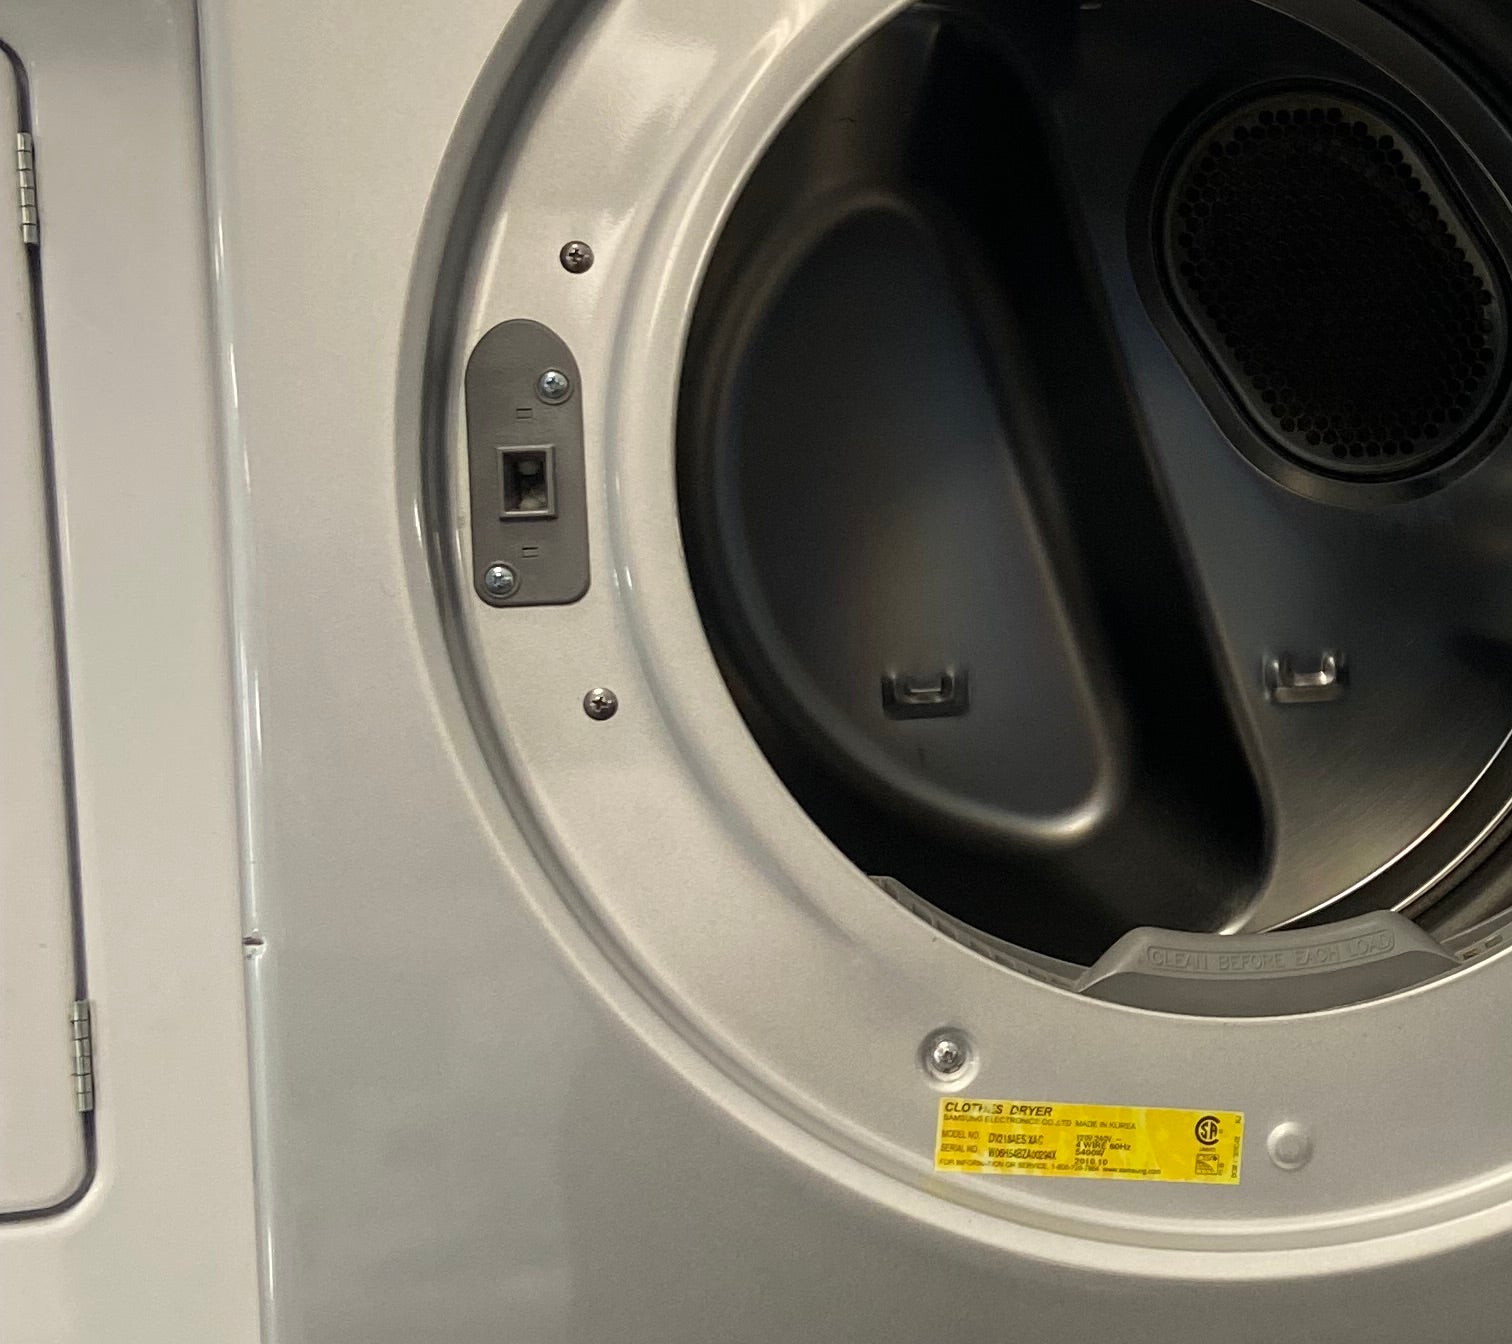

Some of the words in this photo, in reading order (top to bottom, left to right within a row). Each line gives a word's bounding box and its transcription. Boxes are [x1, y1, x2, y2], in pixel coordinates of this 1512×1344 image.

[1150, 949, 1209, 971] CLEAN
[1216, 952, 1287, 972] BEFORE
[1294, 943, 1341, 966] EACH
[944, 1101, 1003, 1115] CLOTS
[1010, 1105, 1053, 1117] DRYER
